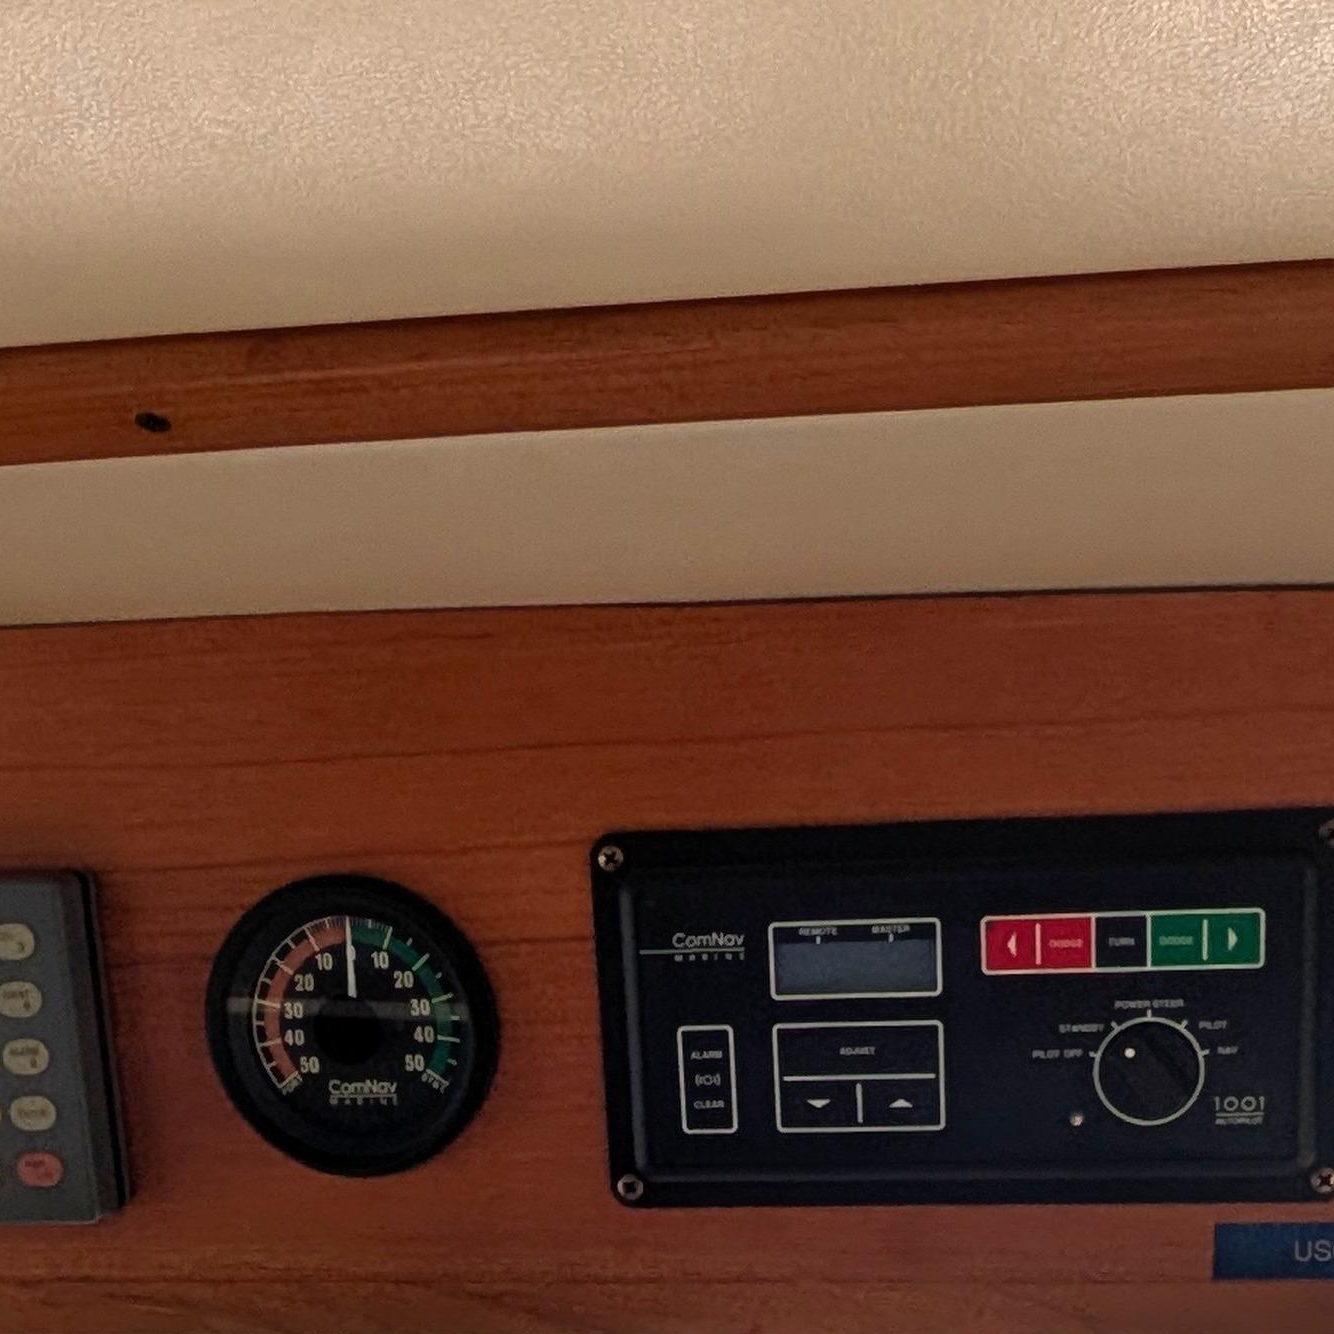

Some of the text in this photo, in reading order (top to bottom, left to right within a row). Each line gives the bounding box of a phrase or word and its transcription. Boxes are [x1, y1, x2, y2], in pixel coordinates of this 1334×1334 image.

[672, 932, 745, 948] ComNav
[316, 952, 333, 971] 10
[370, 951, 389, 970] 10
[294, 973, 315, 992] 20
[393, 970, 414, 989] 20
[283, 1002, 304, 1019] 30
[410, 998, 431, 1016] 30
[284, 1029, 305, 1046] 40
[413, 1026, 434, 1043] 40
[300, 1056, 320, 1075] 50
[404, 1054, 425, 1072] 50
[328, 1079, 398, 1095] ComNav
[693, 1100, 725, 1109] CLEAR
[1213, 1096, 1265, 1111] 1001
